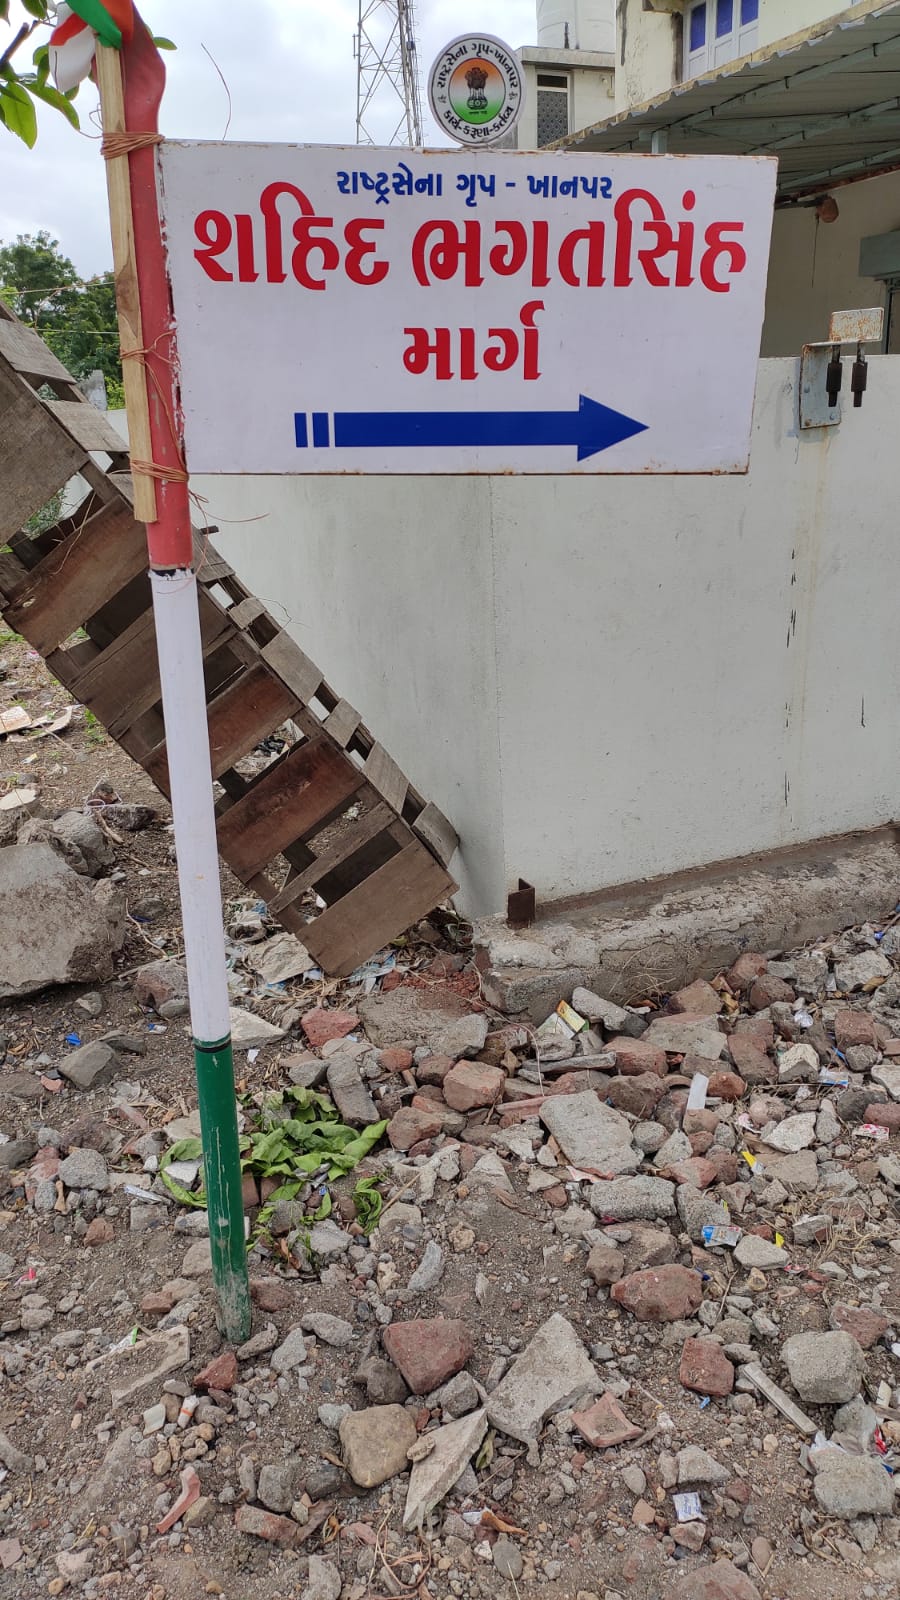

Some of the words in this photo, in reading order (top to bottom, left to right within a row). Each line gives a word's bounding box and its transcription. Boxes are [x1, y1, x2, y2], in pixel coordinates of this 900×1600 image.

[337, 162, 442, 204] રાષ્ટ્રસેના
[456, 174, 496, 207] ગૃપ
[527, 175, 613, 199] ખાનપર
[193, 181, 390, 291] શહિદ
[411, 188, 747, 293] ભગતસિંહ
[402, 300, 545, 381] માર્ગ
